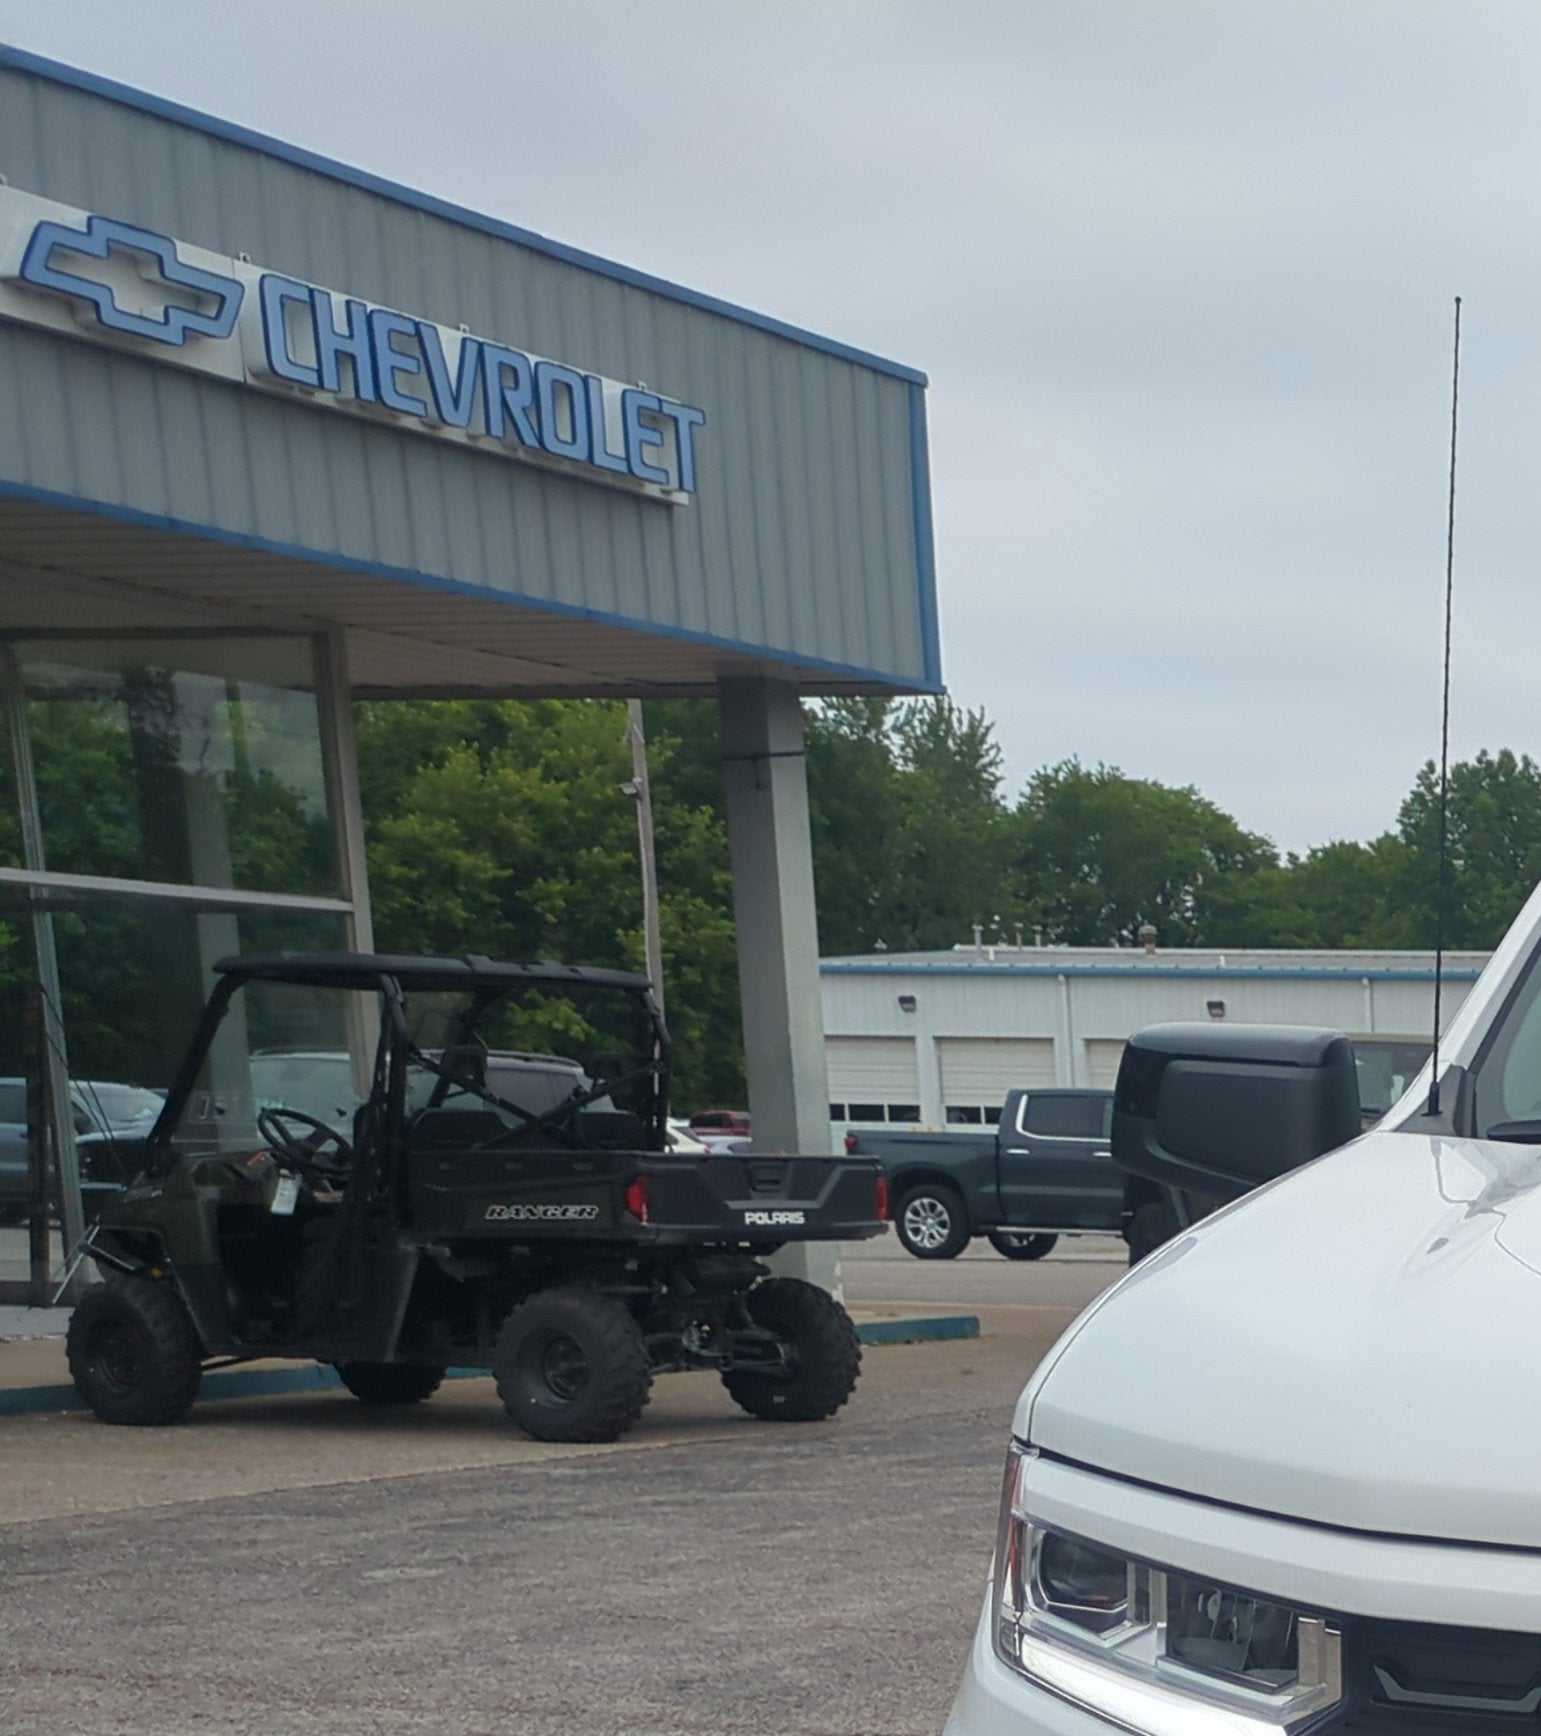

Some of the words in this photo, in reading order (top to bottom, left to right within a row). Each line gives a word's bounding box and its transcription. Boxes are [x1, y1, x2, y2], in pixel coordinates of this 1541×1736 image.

[259, 272, 706, 493] CHEVROLET
[485, 1204, 599, 1220] RANGER
[744, 1211, 806, 1225] POLARIS
